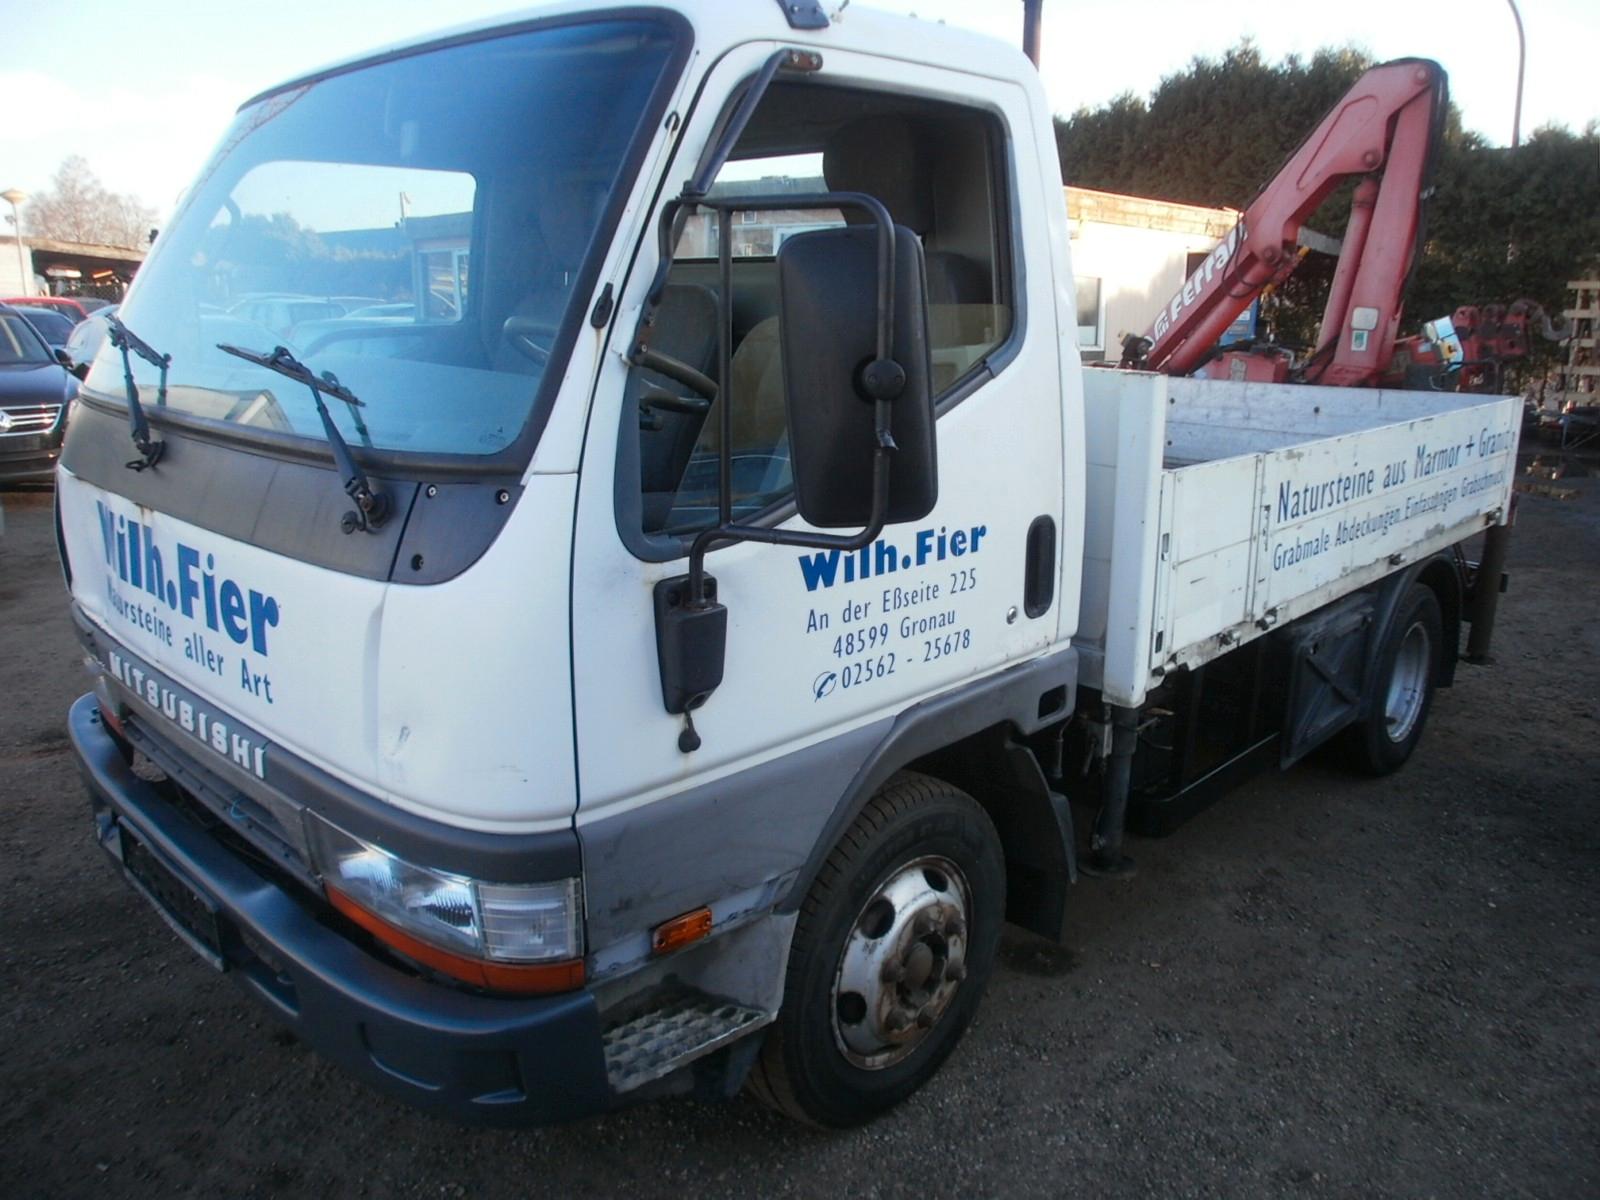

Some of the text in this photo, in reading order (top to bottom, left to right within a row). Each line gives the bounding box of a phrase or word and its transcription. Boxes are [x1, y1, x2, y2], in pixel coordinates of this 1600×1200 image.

[1277, 462, 1375, 524] Natursteine
[1383, 459, 1407, 489] aus
[1414, 443, 1462, 479] Marmor
[1466, 435, 1475, 457] +
[798, 525, 987, 592] Wilh.Fier
[1273, 527, 1330, 571] Grabmale
[1334, 507, 1401, 547] Abdeckungen
[807, 568, 977, 633] An der Eßseite 225
[833, 609, 956, 658] 48599 Gronau
[185, 632, 224, 676] aller
[241, 658, 273, 704] Art
[841, 652, 896, 688] 02562
[923, 628, 971, 663] 25678
[109, 651, 266, 779] MITSUBISHI
